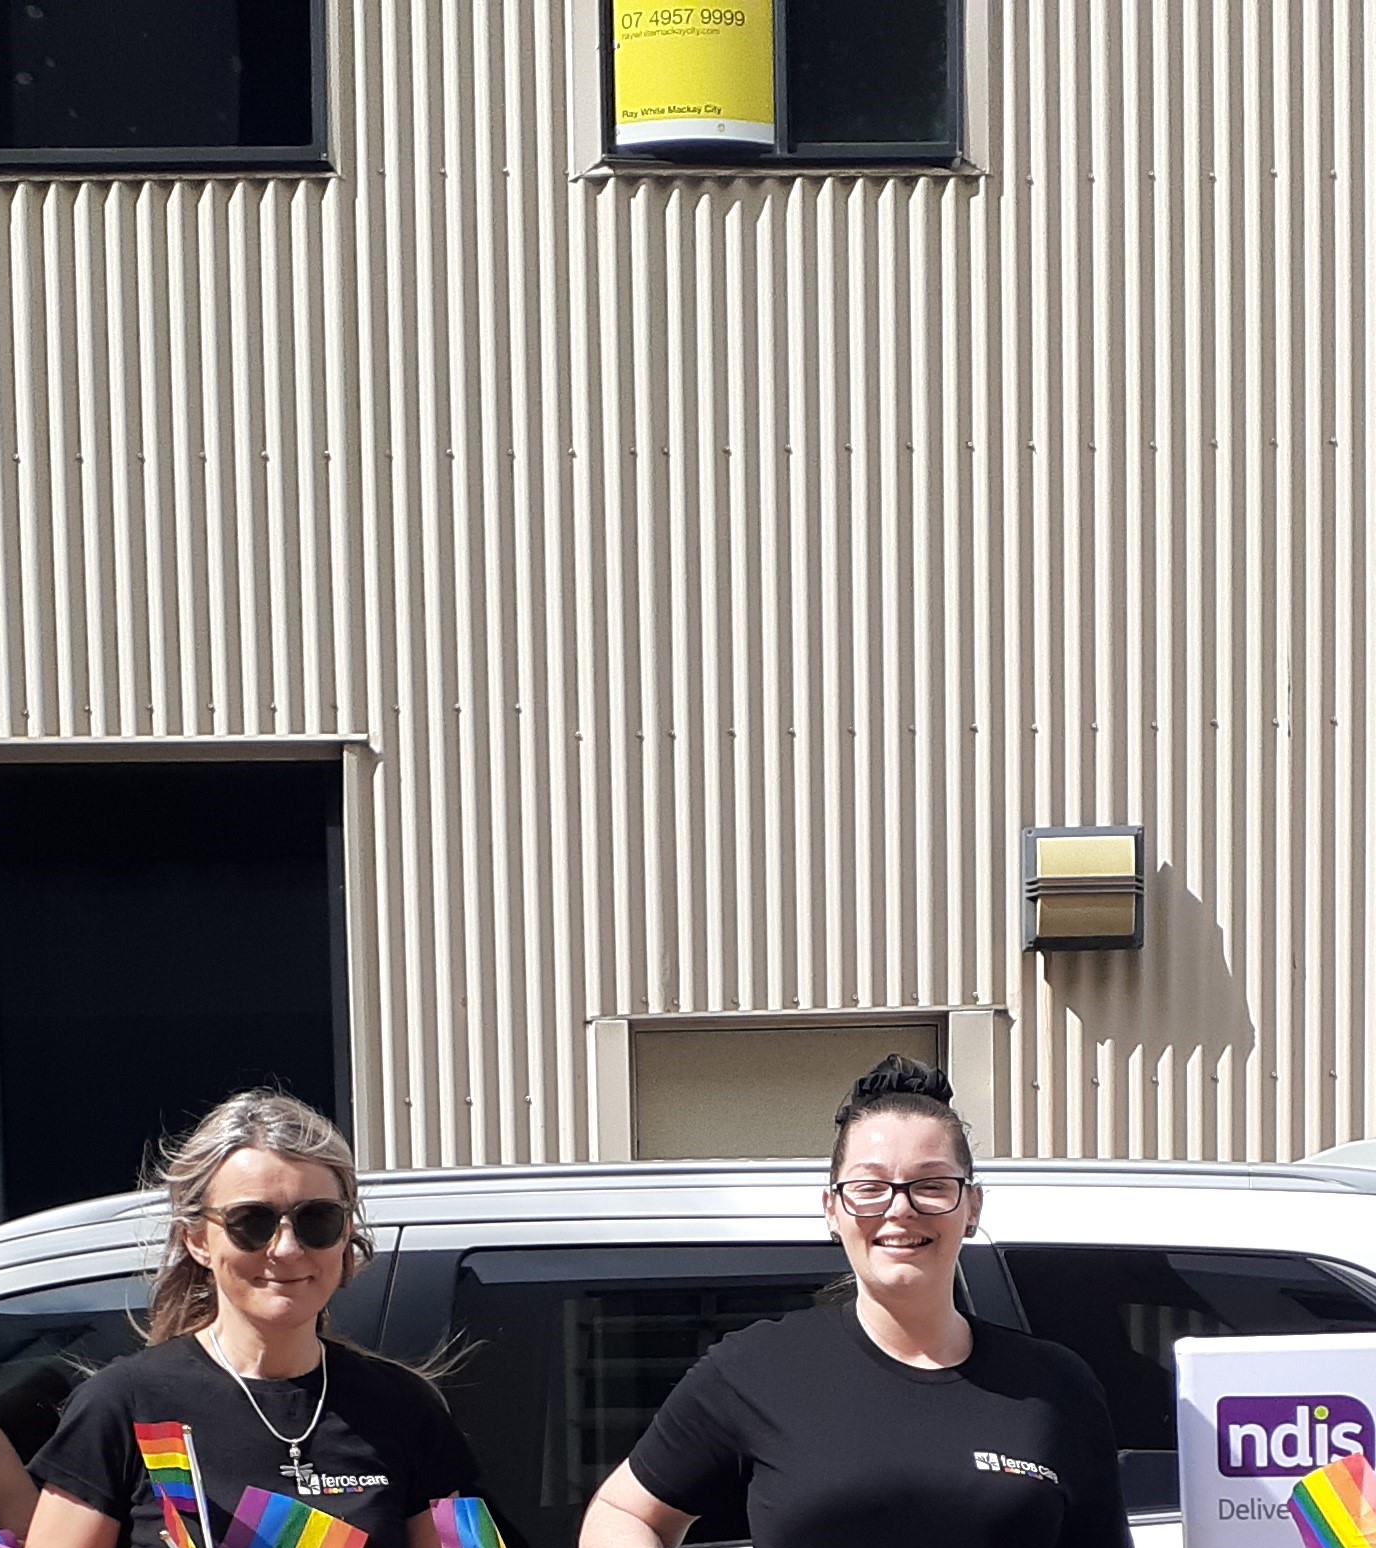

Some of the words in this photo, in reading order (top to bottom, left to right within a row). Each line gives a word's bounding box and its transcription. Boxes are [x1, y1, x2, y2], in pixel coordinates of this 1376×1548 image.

[621, 12, 643, 29] 07
[649, 9, 694, 26] 4957
[700, 8, 746, 26] 9999
[622, 110, 638, 119] Ray
[640, 108, 665, 117] White
[667, 105, 702, 115] Mackay
[704, 104, 722, 115] City
[1229, 1405, 1364, 1467] ndis
[321, 1473, 358, 1487] feros
[359, 1474, 389, 1486] care
[1218, 1498, 1290, 1520] Delive
